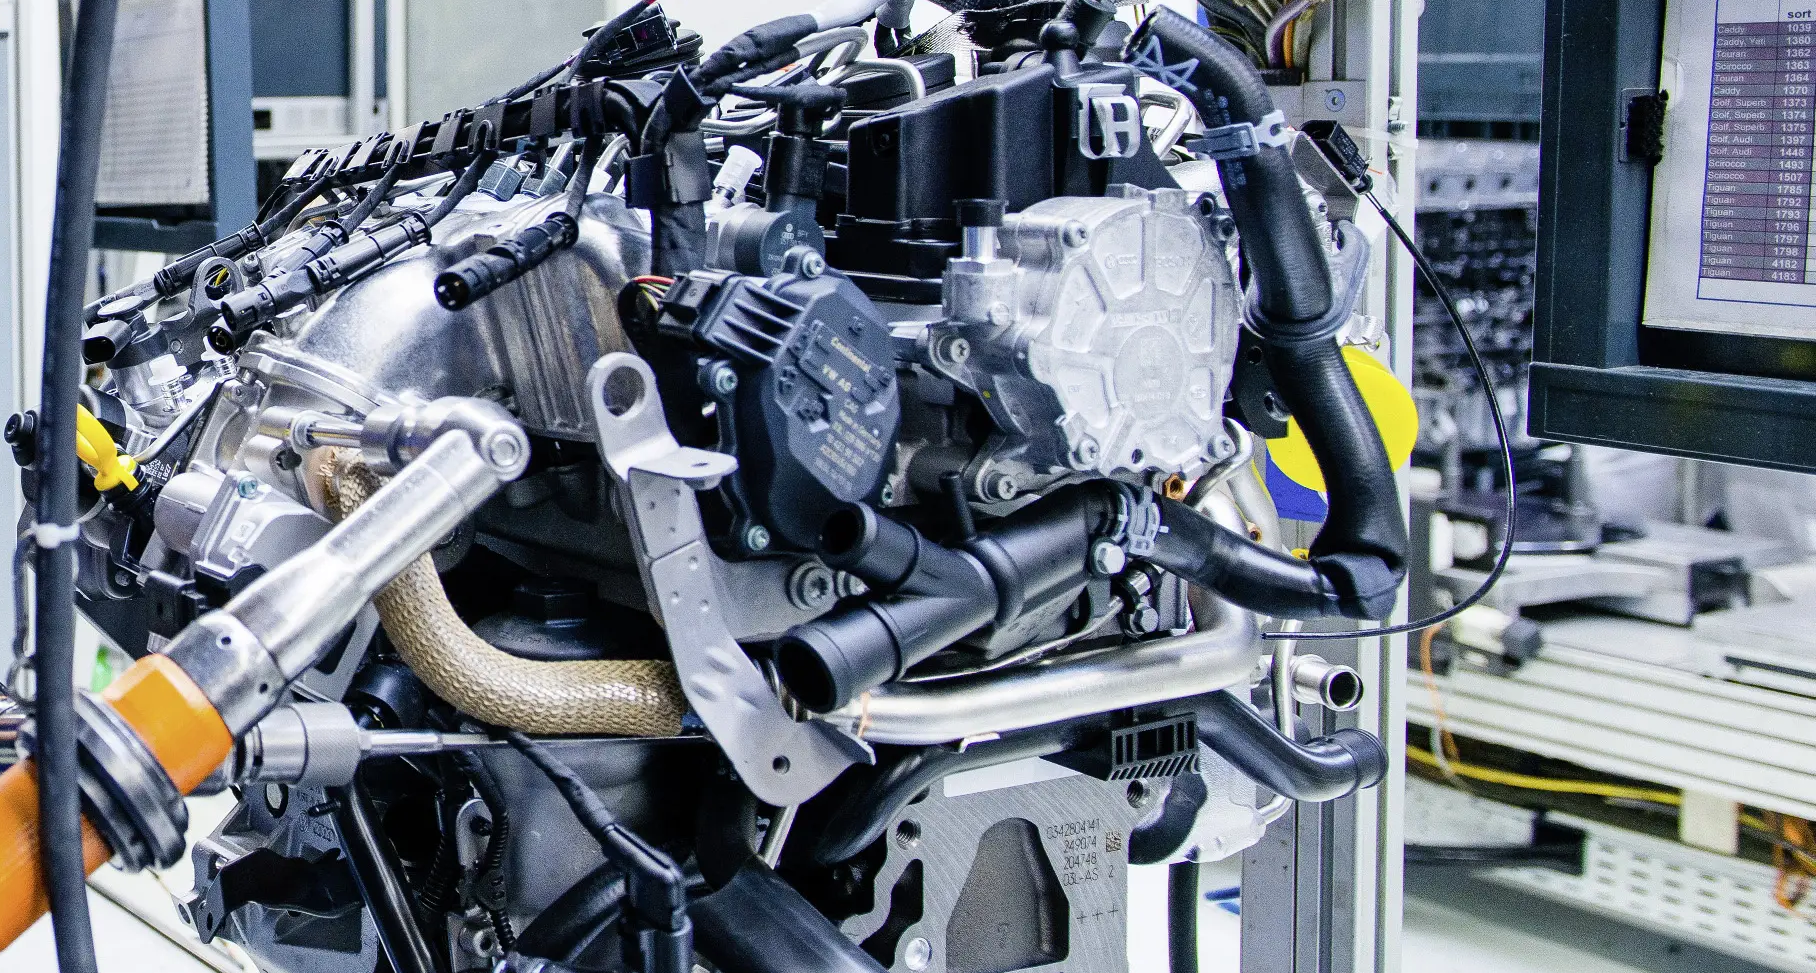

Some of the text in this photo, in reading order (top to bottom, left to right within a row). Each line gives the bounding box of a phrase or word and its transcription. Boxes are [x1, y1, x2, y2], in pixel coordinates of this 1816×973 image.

[1787, 10, 1812, 19] sort
[1717, 24, 1811, 34] Caddy 1039
[1787, 36, 1811, 45] 1360
[1786, 49, 1810, 57] 1362
[1714, 61, 1810, 70] Scirocco 1363
[1714, 74, 1809, 82] Touran 1364
[1713, 86, 1808, 95] Caddy 1370
[1736, 99, 1766, 108] Superb
[1783, 99, 1807, 107] 1373
[1734, 111, 1765, 120] Superb
[1782, 111, 1806, 119] 1374
[1734, 123, 1764, 132] Superb
[1781, 123, 1806, 132] 1375
[1781, 136, 1805, 144] 1397
[1732, 147, 1752, 155] Audi
[1779, 148, 1804, 157] 1448
[1708, 160, 1804, 169] Scirocco 1493
[1707, 171, 1803, 181] Scirocco 1507
[1707, 183, 1802, 194] Tiguan 1785
[1706, 196, 1801, 206] Tiguan 1792
[1705, 208, 1800, 219] Tiguan 1793
[1704, 219, 1799, 231] Tiguan 1796
[1704, 232, 1799, 243] Tiguan 1797
[1703, 244, 1798, 256] Tiguan 1798
[1703, 256, 1798, 268] Tiguan 4182
[1702, 268, 1796, 281] Tiguan 4183
[831, 336, 871, 373] Continental
